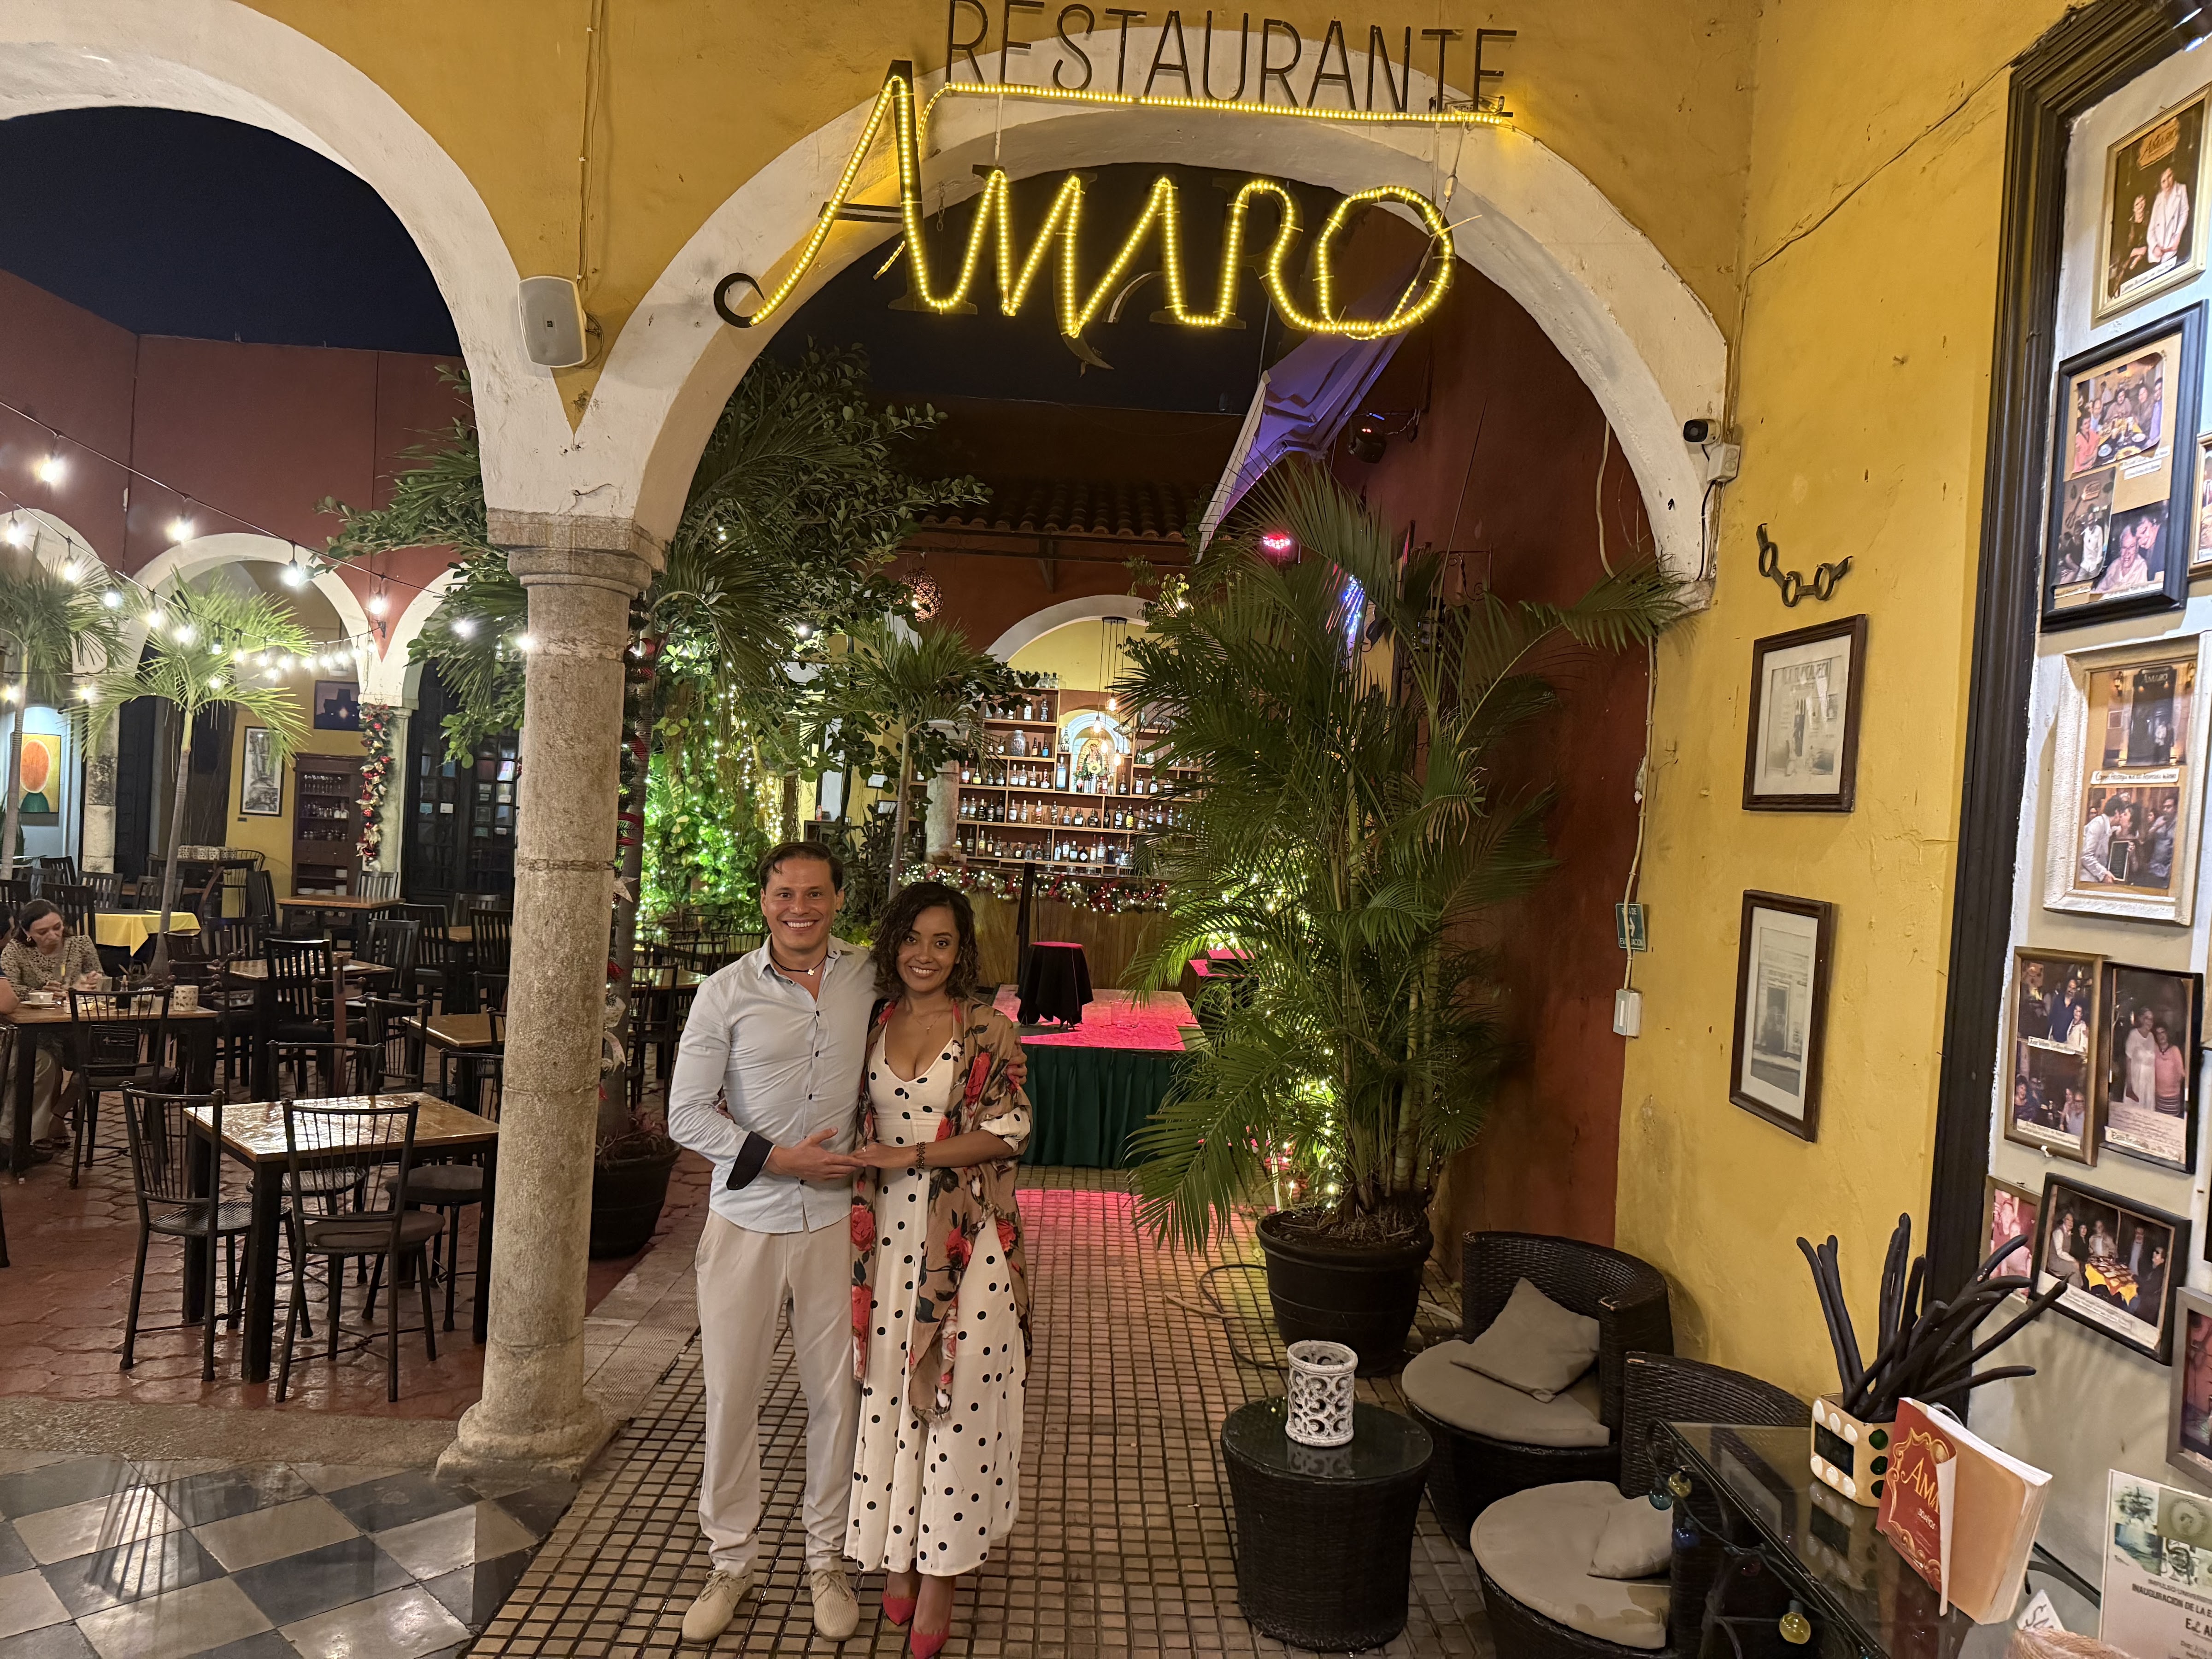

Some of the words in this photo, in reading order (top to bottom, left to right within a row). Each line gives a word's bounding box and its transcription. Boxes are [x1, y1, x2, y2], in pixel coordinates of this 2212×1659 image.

[945, 0, 1517, 118] RESTAURANTE
[713, 60, 1455, 355] AMARO
[2184, 1601, 2194, 1612] DE
[2195, 1605, 2206, 1616] LA
